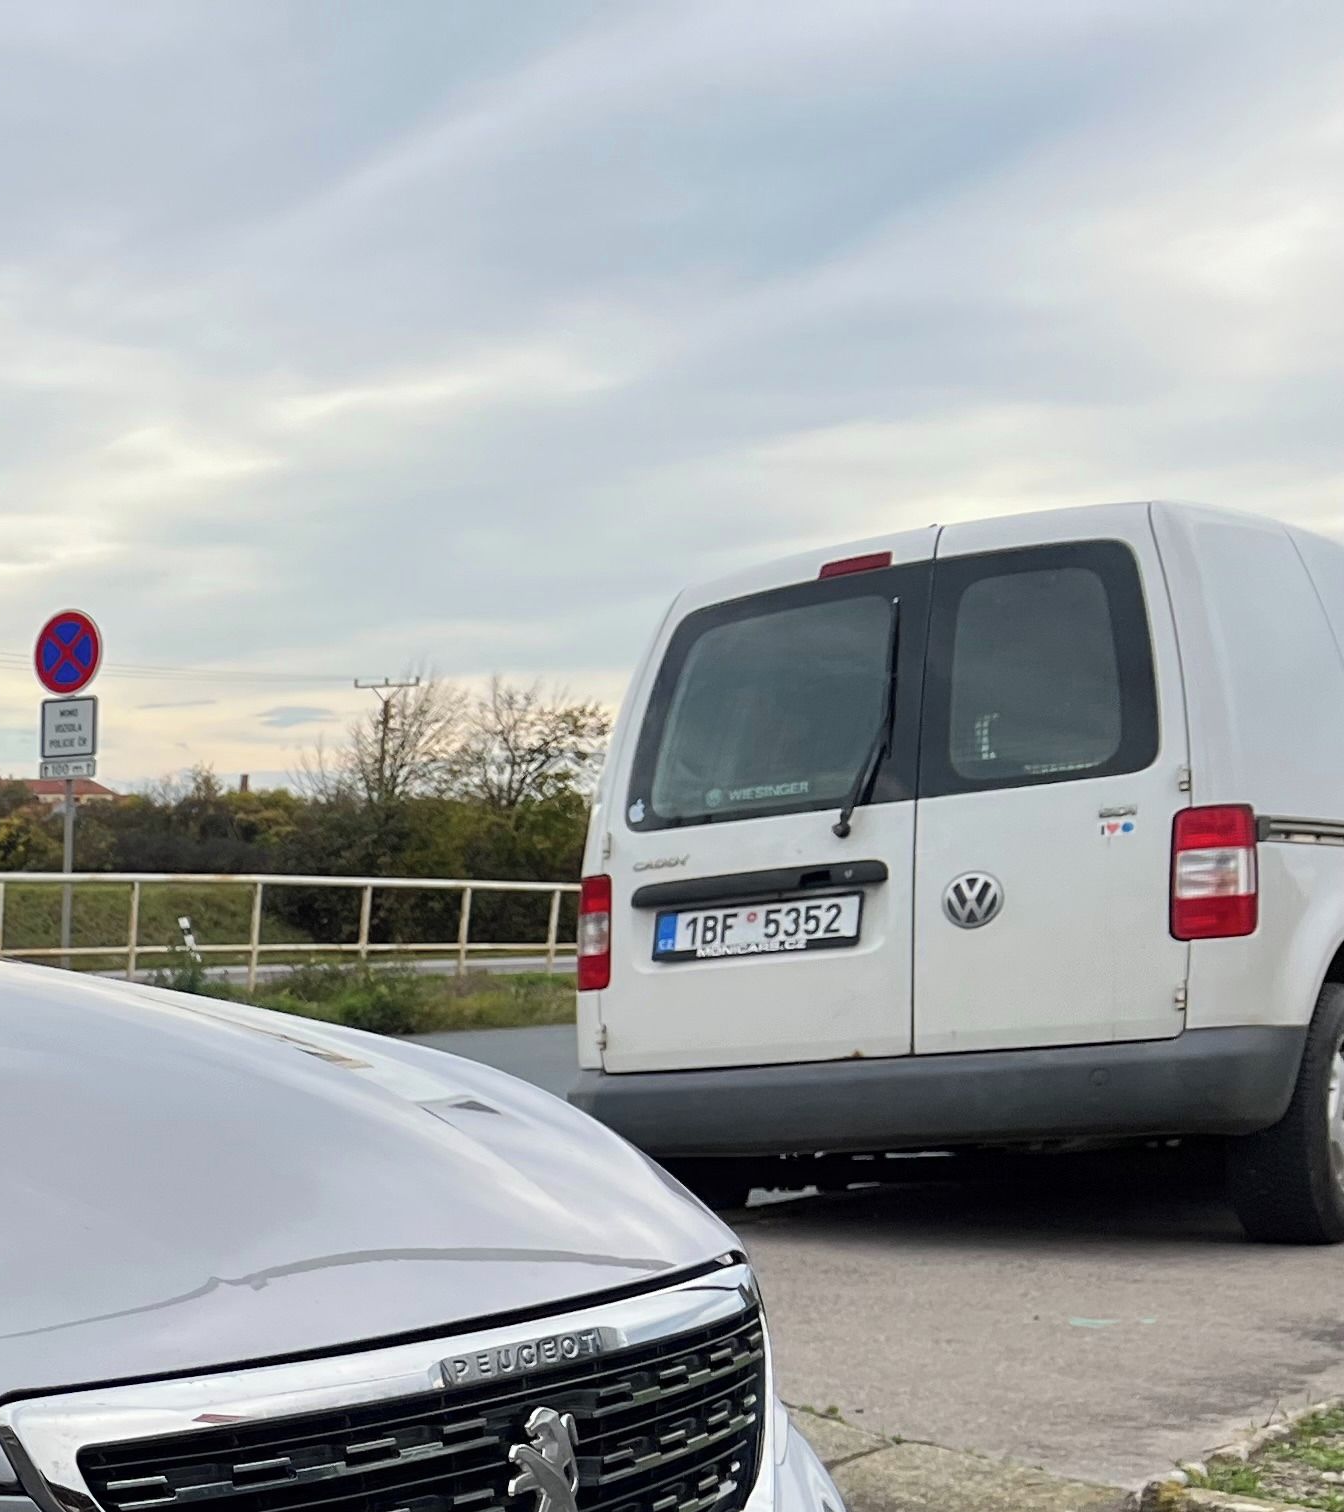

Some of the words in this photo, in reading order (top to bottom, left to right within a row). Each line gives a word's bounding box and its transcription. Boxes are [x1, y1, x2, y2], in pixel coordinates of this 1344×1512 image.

[728, 781, 809, 801] WIESINGER
[685, 913, 738, 947] 1BF
[763, 903, 843, 939] 5352
[696, 938, 808, 958] MONICARS.CZ
[452, 1332, 597, 1383] PEUGEOT
